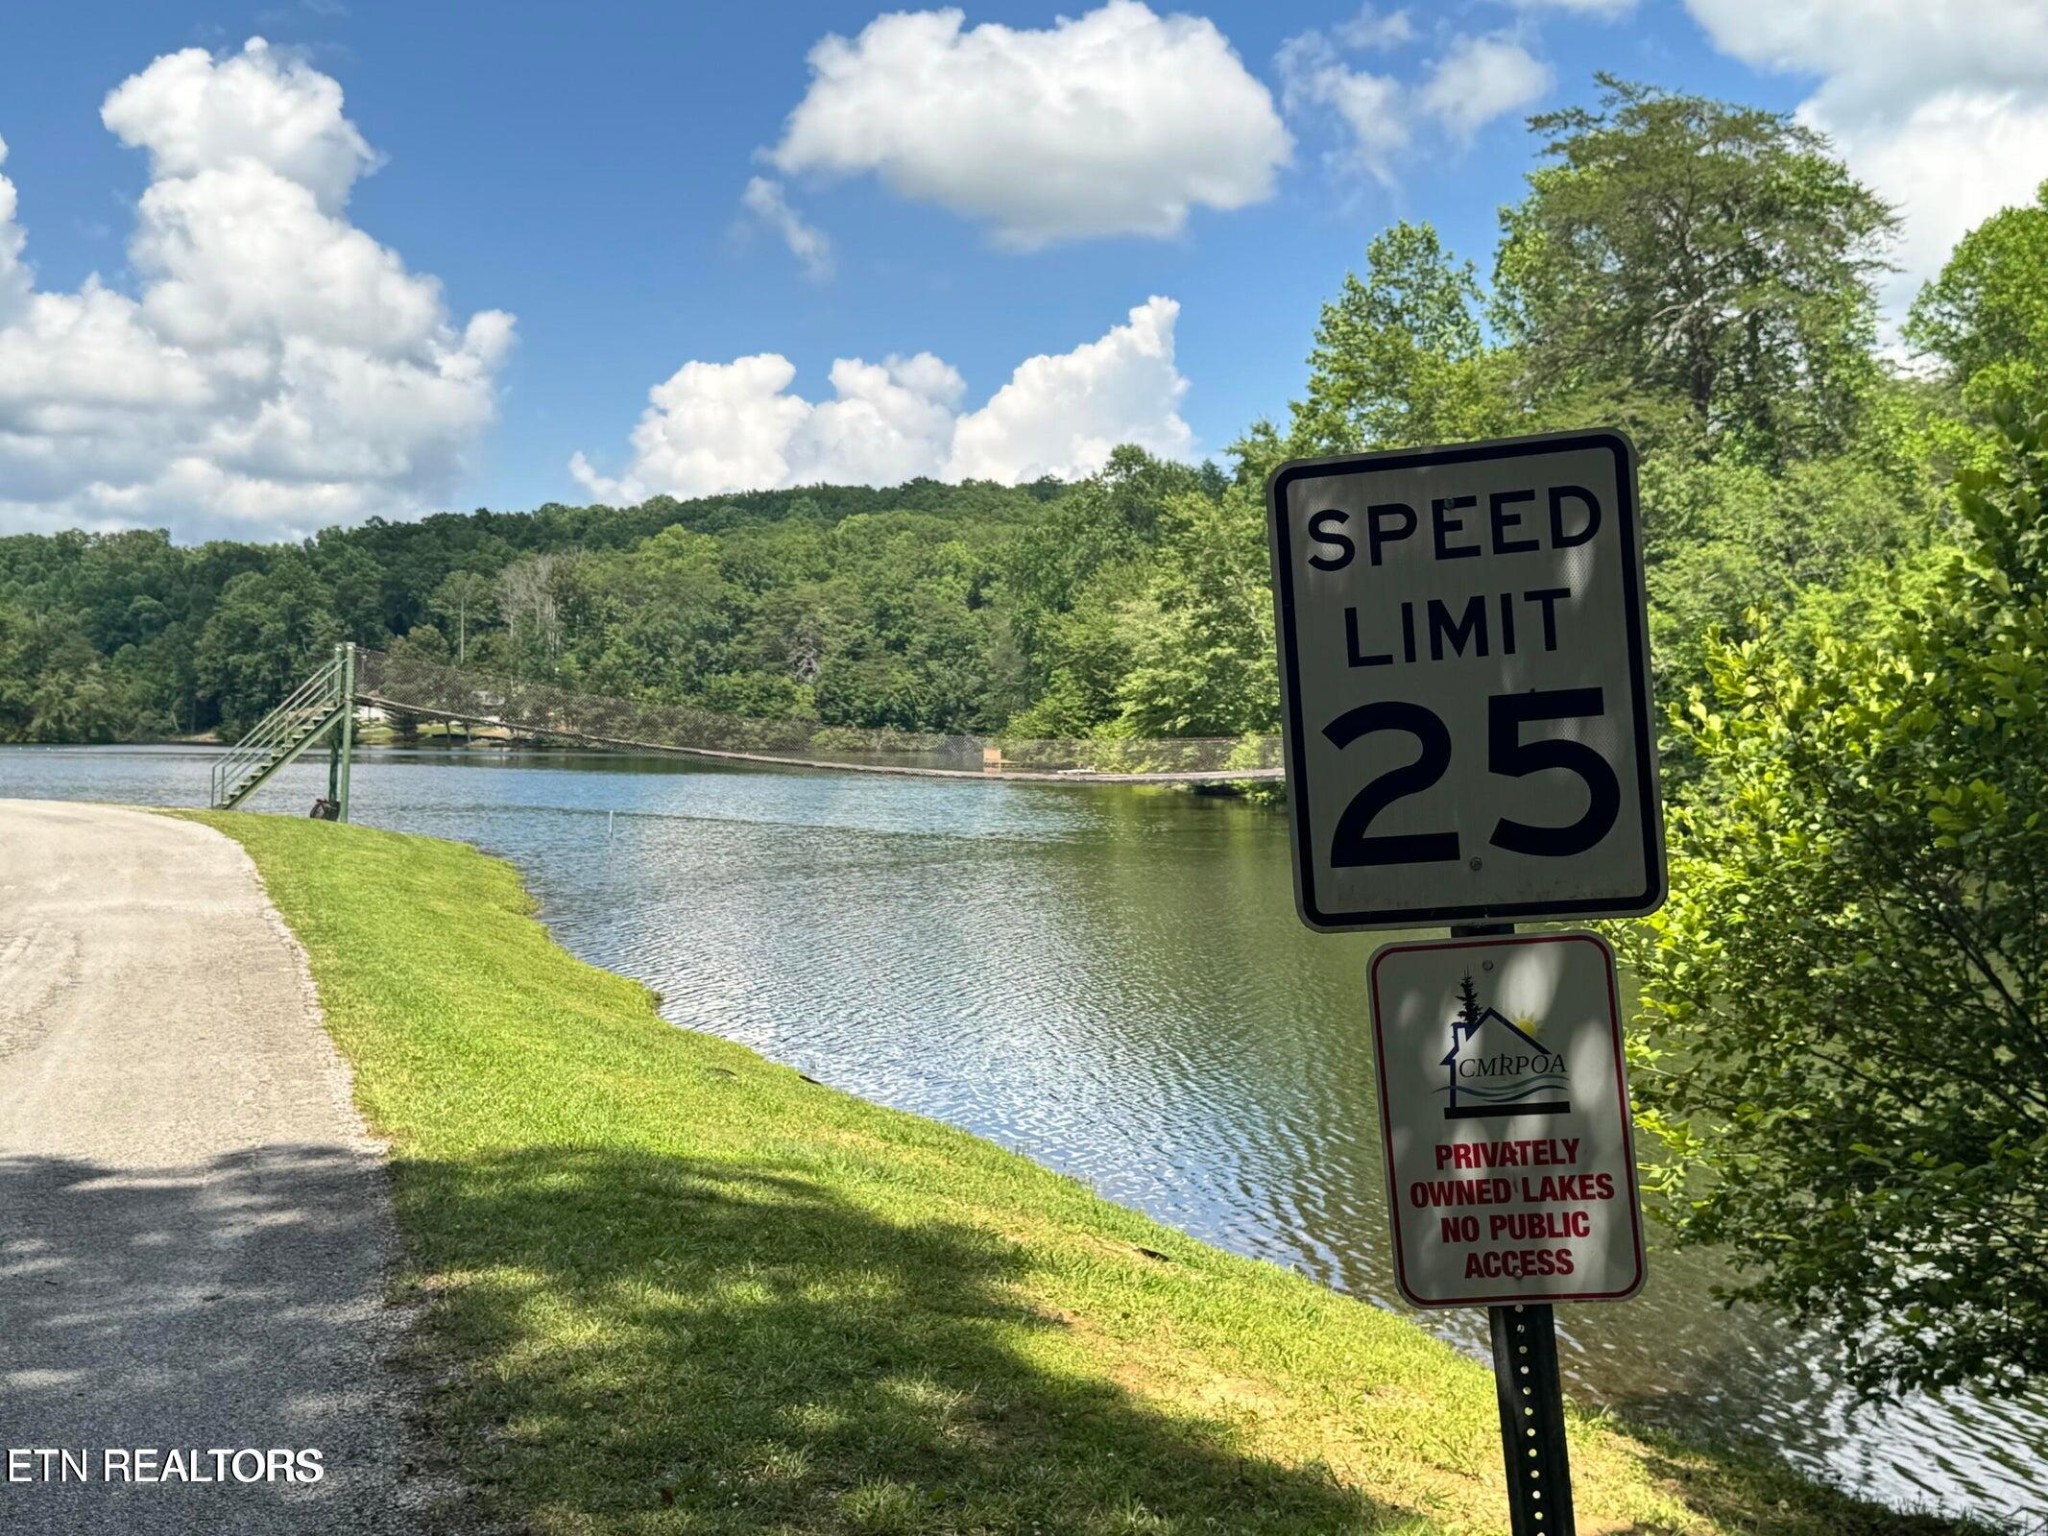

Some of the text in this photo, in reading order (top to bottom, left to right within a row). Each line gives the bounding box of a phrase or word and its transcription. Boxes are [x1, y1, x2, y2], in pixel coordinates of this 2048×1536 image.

[1308, 485, 1602, 572] SPEED
[1344, 588, 1571, 668] LIMIT
[1321, 687, 1621, 868] 25
[1458, 1053, 1567, 1079] CMRPOA
[1435, 1138, 1580, 1170] PRIVATELY
[1410, 1173, 1615, 1208] OWNED LAKES
[1441, 1211, 1591, 1244] NO PUBLIC
[1464, 1248, 1575, 1279] ACCESS
